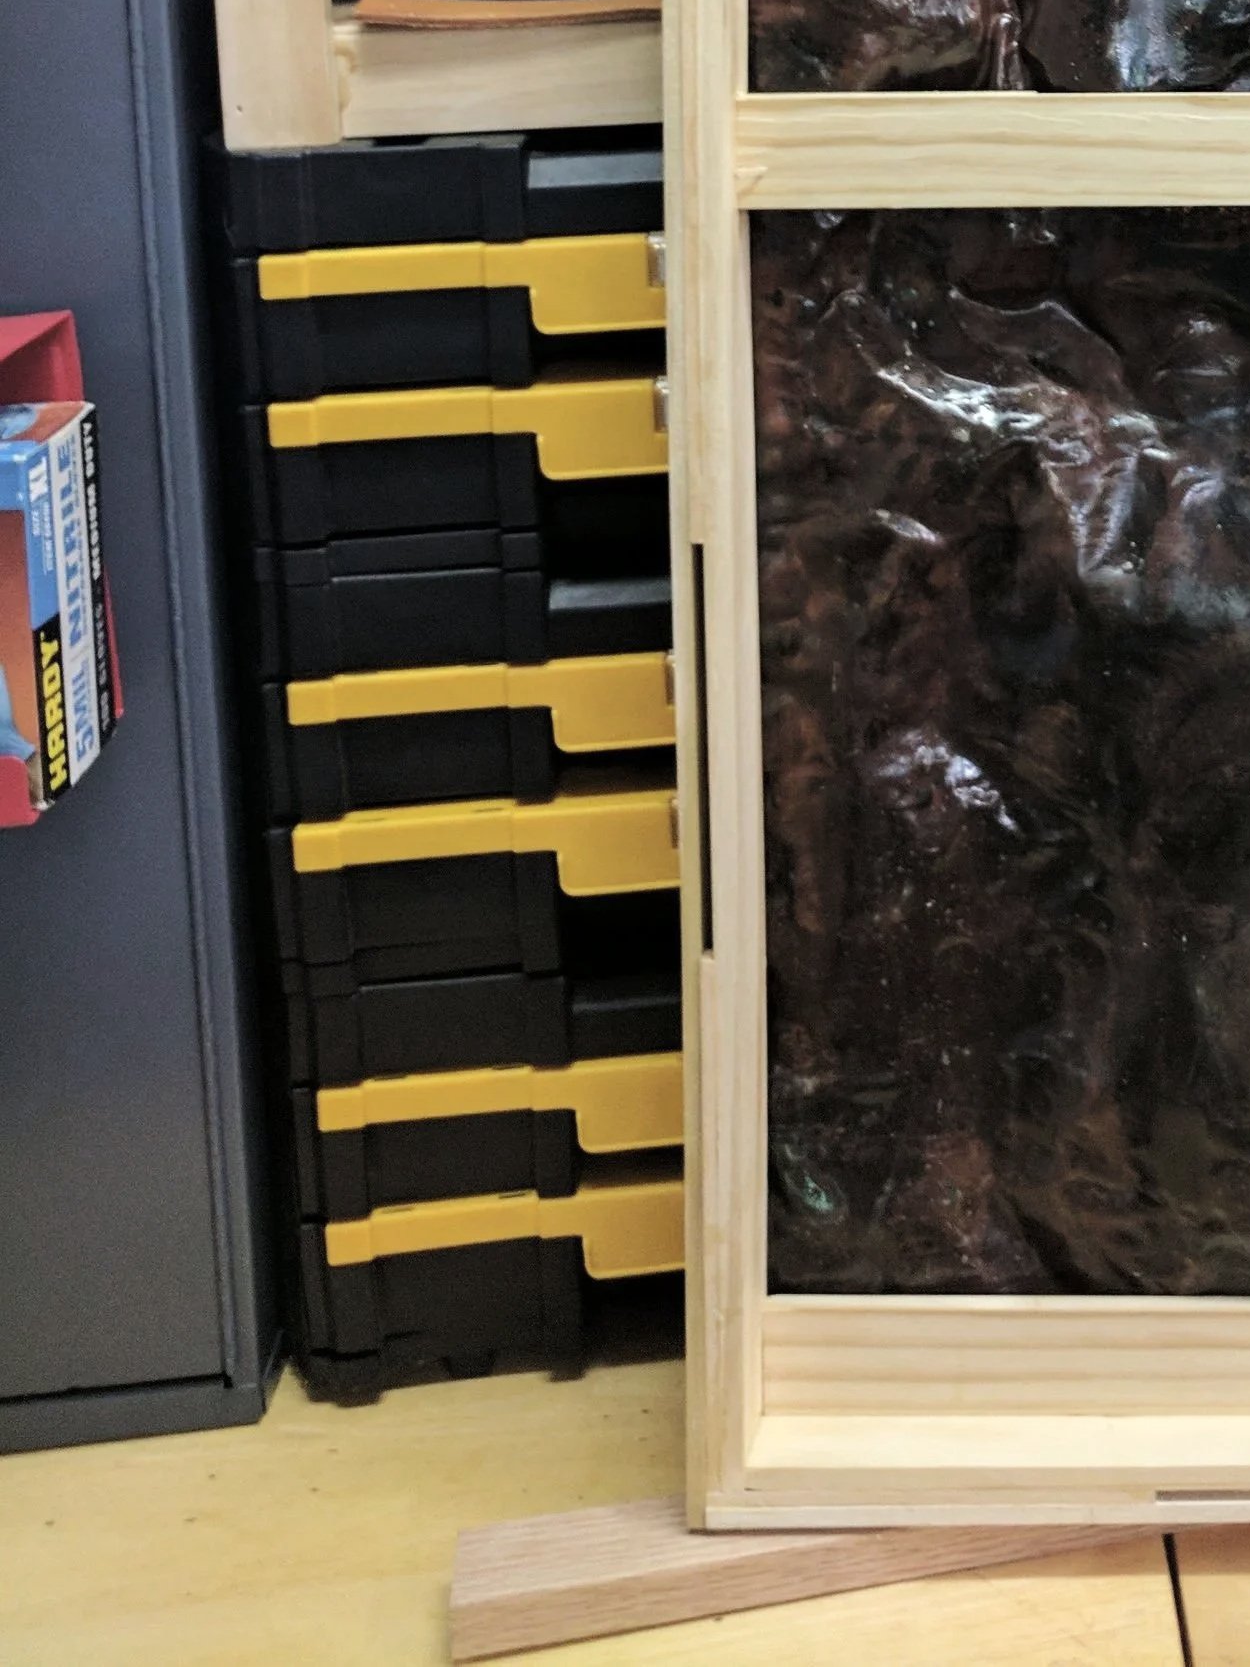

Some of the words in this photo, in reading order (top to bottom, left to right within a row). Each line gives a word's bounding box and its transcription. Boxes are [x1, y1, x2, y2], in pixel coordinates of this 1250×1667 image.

[28, 456, 48, 504] XL
[57, 438, 85, 647] NITRILE
[40, 638, 68, 792] HARDY
